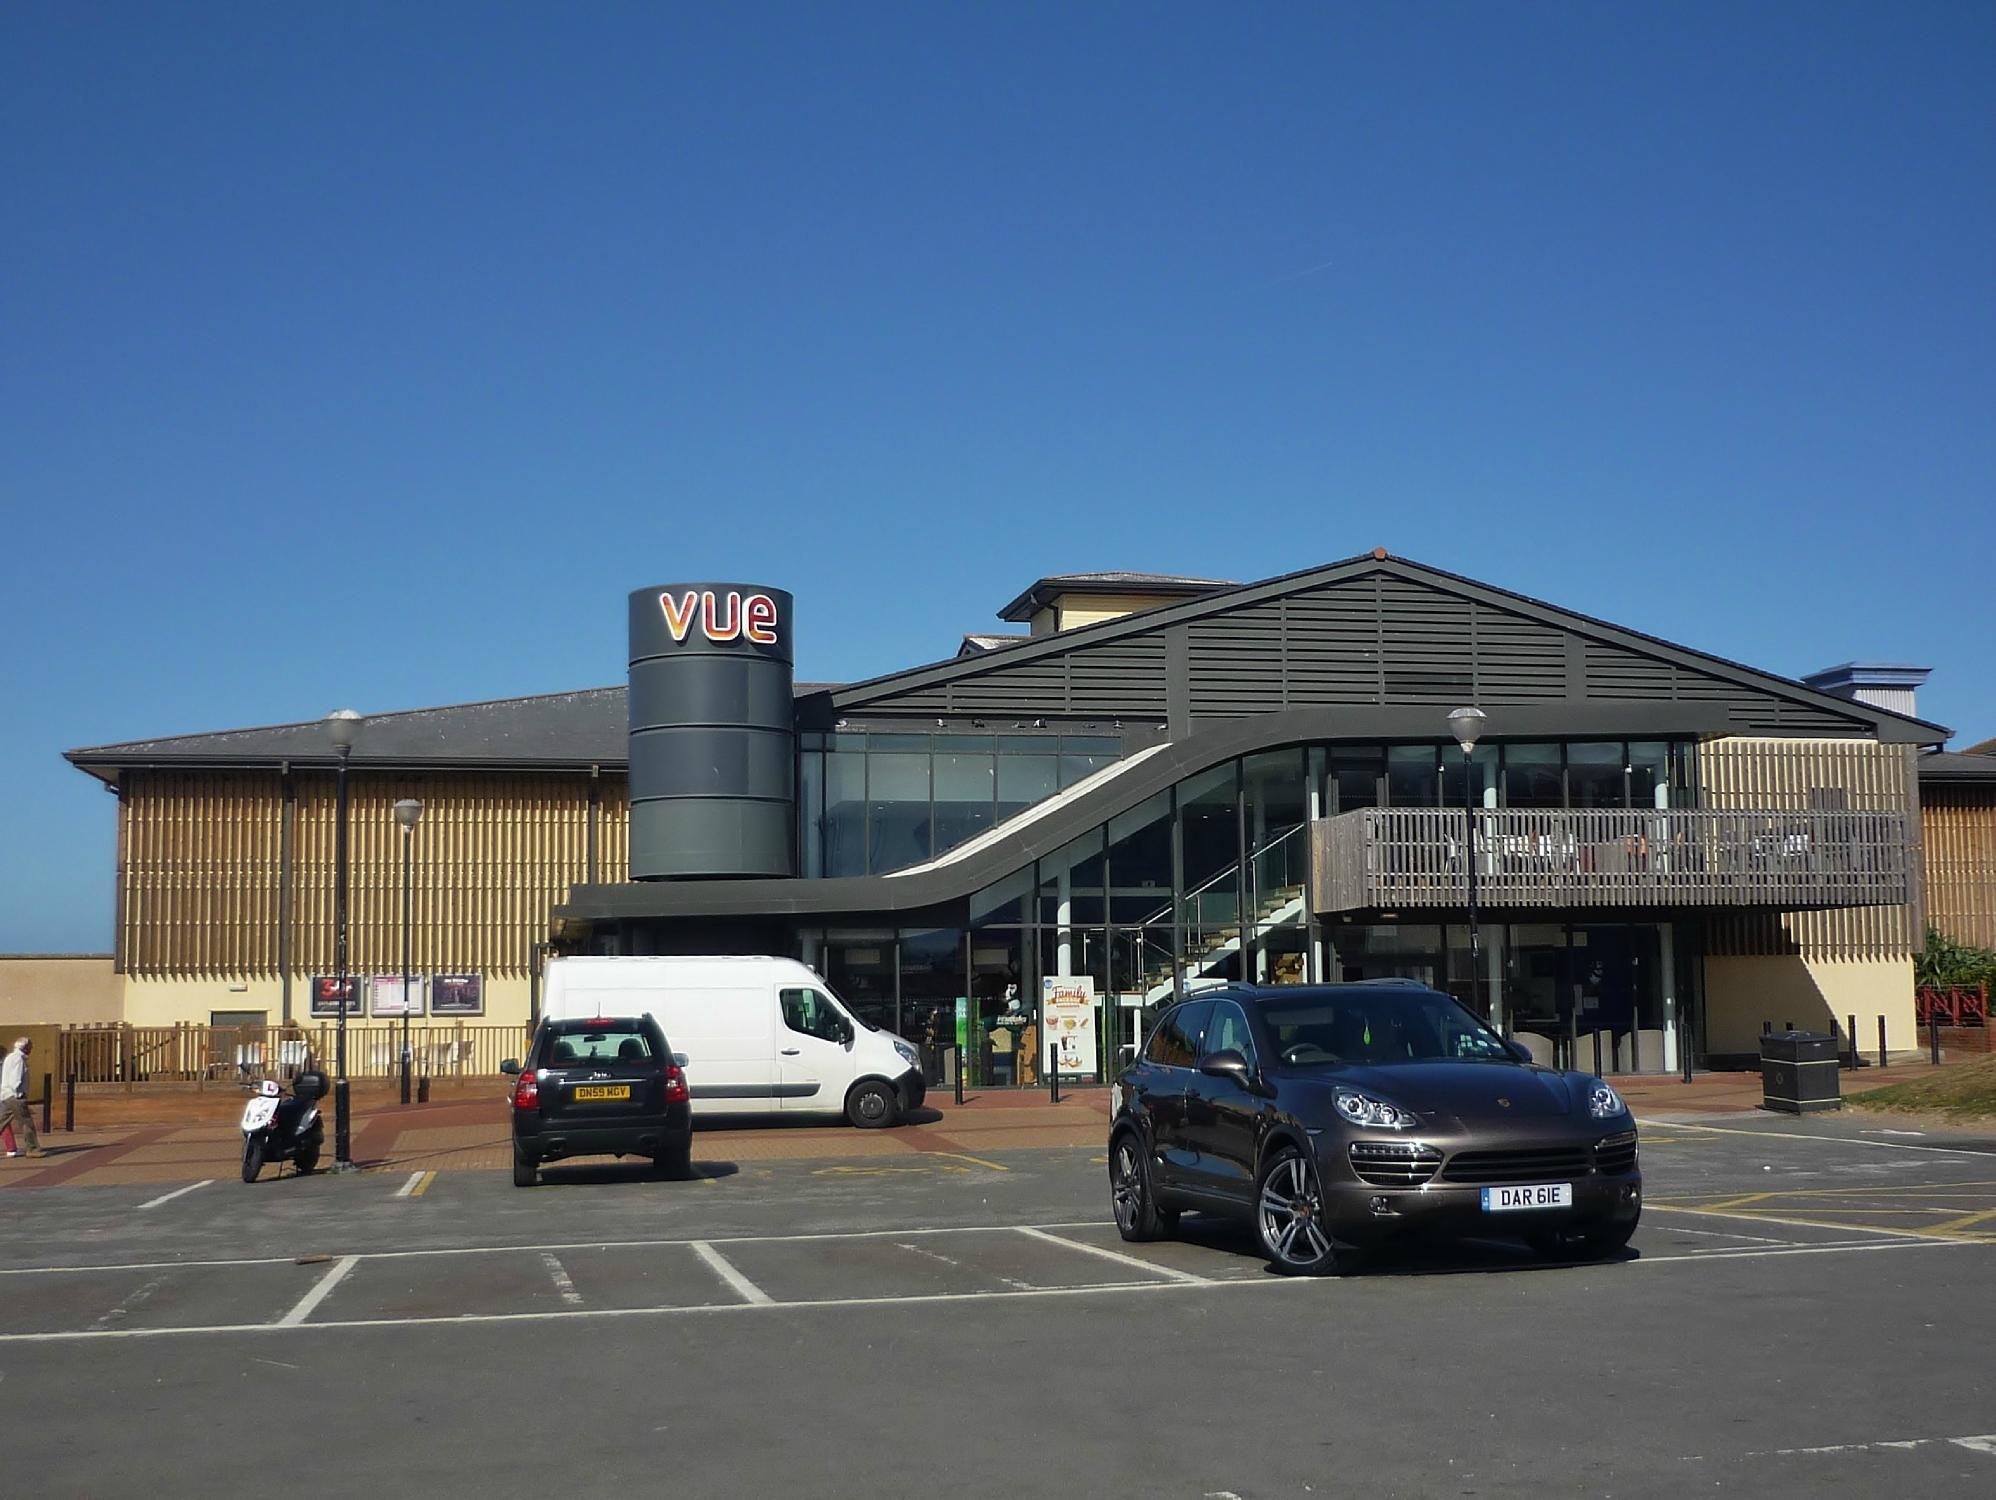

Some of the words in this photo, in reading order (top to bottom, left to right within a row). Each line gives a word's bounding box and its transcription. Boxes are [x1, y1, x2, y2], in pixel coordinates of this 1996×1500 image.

[1052, 985, 1086, 999] Family
[268, 1083, 275, 1092] L
[579, 1088, 604, 1098] DN59
[1501, 1189, 1533, 1206] DAR
